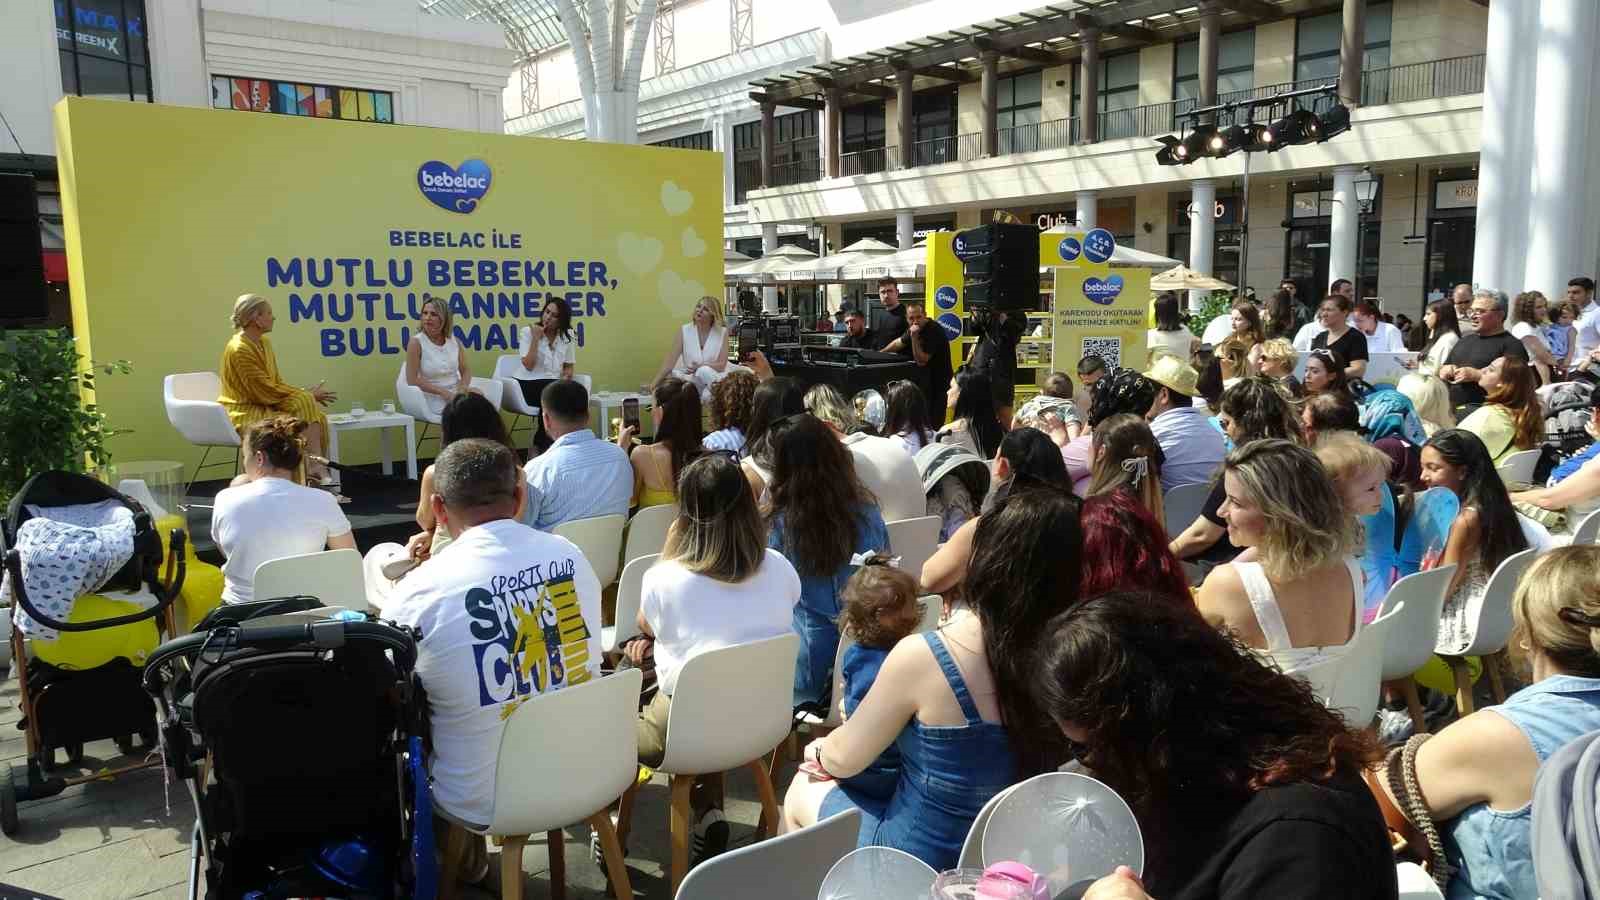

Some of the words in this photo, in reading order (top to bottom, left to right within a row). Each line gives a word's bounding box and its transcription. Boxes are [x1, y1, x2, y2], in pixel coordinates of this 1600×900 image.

[422, 170, 486, 189] bebelac
[1038, 213, 1067, 230] Club
[389, 230, 485, 248] BEBELAC
[492, 229, 522, 249] İLE
[267, 257, 413, 287] MUTLU
[427, 259, 618, 290] BEBEKLER,
[1084, 282, 1121, 291] bebelac
[448, 292, 606, 319] ANNEER
[491, 564, 543, 597] SPORTS
[549, 558, 575, 580] CLUB
